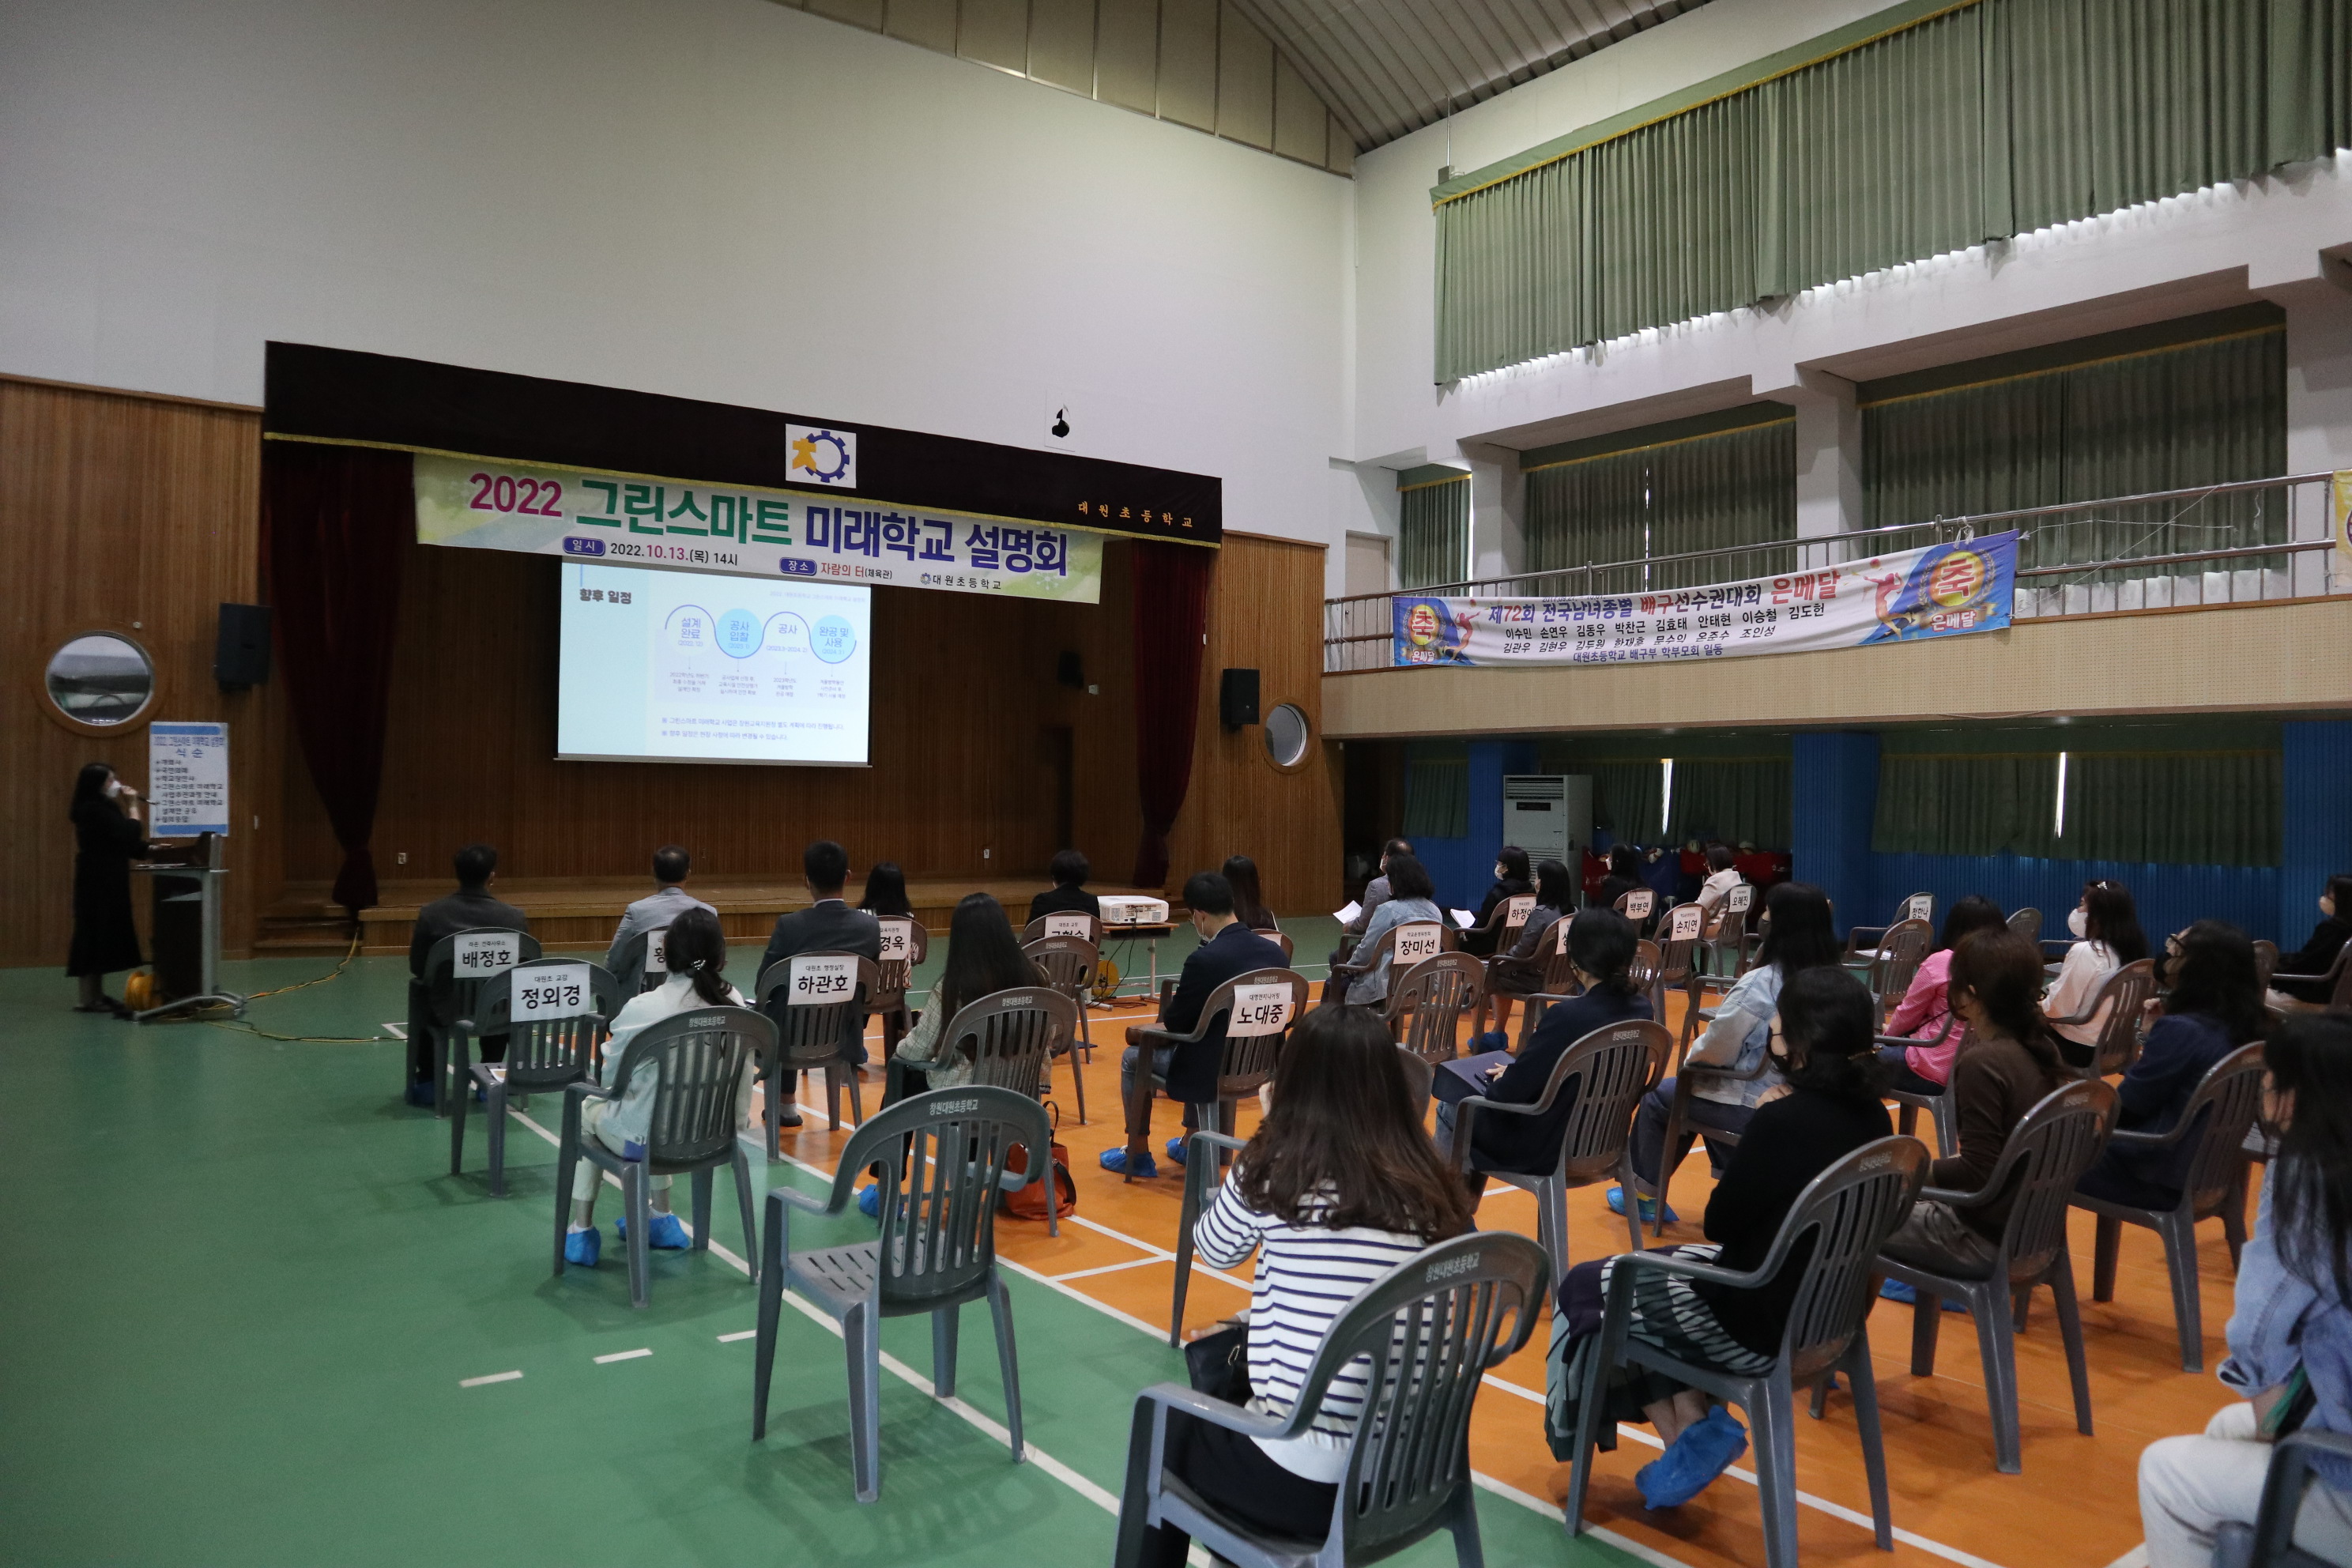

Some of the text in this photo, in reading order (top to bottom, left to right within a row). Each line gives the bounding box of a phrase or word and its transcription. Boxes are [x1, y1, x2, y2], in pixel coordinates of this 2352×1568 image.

[469, 473, 1067, 576] 2022 그린스마트 미래학교 설명회
[572, 539, 737, 566] 일시 2022.10.13.(목) 14시
[788, 560, 808, 571] 장소
[820, 562, 851, 577] 자람의
[933, 575, 1001, 590] 대원초등학교
[1938, 558, 1974, 598] 축
[579, 588, 631, 605] 향후 일정
[1489, 570, 1841, 624] 제72회 전국남녀종별 배구선수권대회 은메달
[681, 617, 701, 628] 설계
[729, 620, 749, 631] 공사
[1412, 609, 1435, 641] 축
[1506, 603, 1825, 639] 이수민 손연우 김동우 박찬근 김효태 안태현 이승철 김도헌
[1931, 610, 1977, 631] 은메달
[681, 628, 700, 639] 완료
[729, 631, 749, 642] 입찰
[778, 624, 797, 635] 공사
[819, 626, 849, 638] 완공 및
[824, 638, 843, 648] 사용
[1503, 643, 1531, 654] 김관우
[1539, 642, 1567, 653] 김현우
[1575, 639, 1605, 650] 김두원
[1739, 625, 1776, 639] 조인성
[1574, 643, 1724, 663] 대원초등학교 배구부 학부모회 일동
[1630, 902, 1649, 913] 백부연
[1676, 919, 1698, 933] 손지연
[1400, 939, 1435, 956] 장미선
[462, 950, 511, 968] 배정호
[798, 975, 848, 994] 하관호
[521, 985, 580, 1009] 정외경
[1237, 1004, 1283, 1025] 노대중
[929, 1099, 978, 1116] 창원대원초등학교
